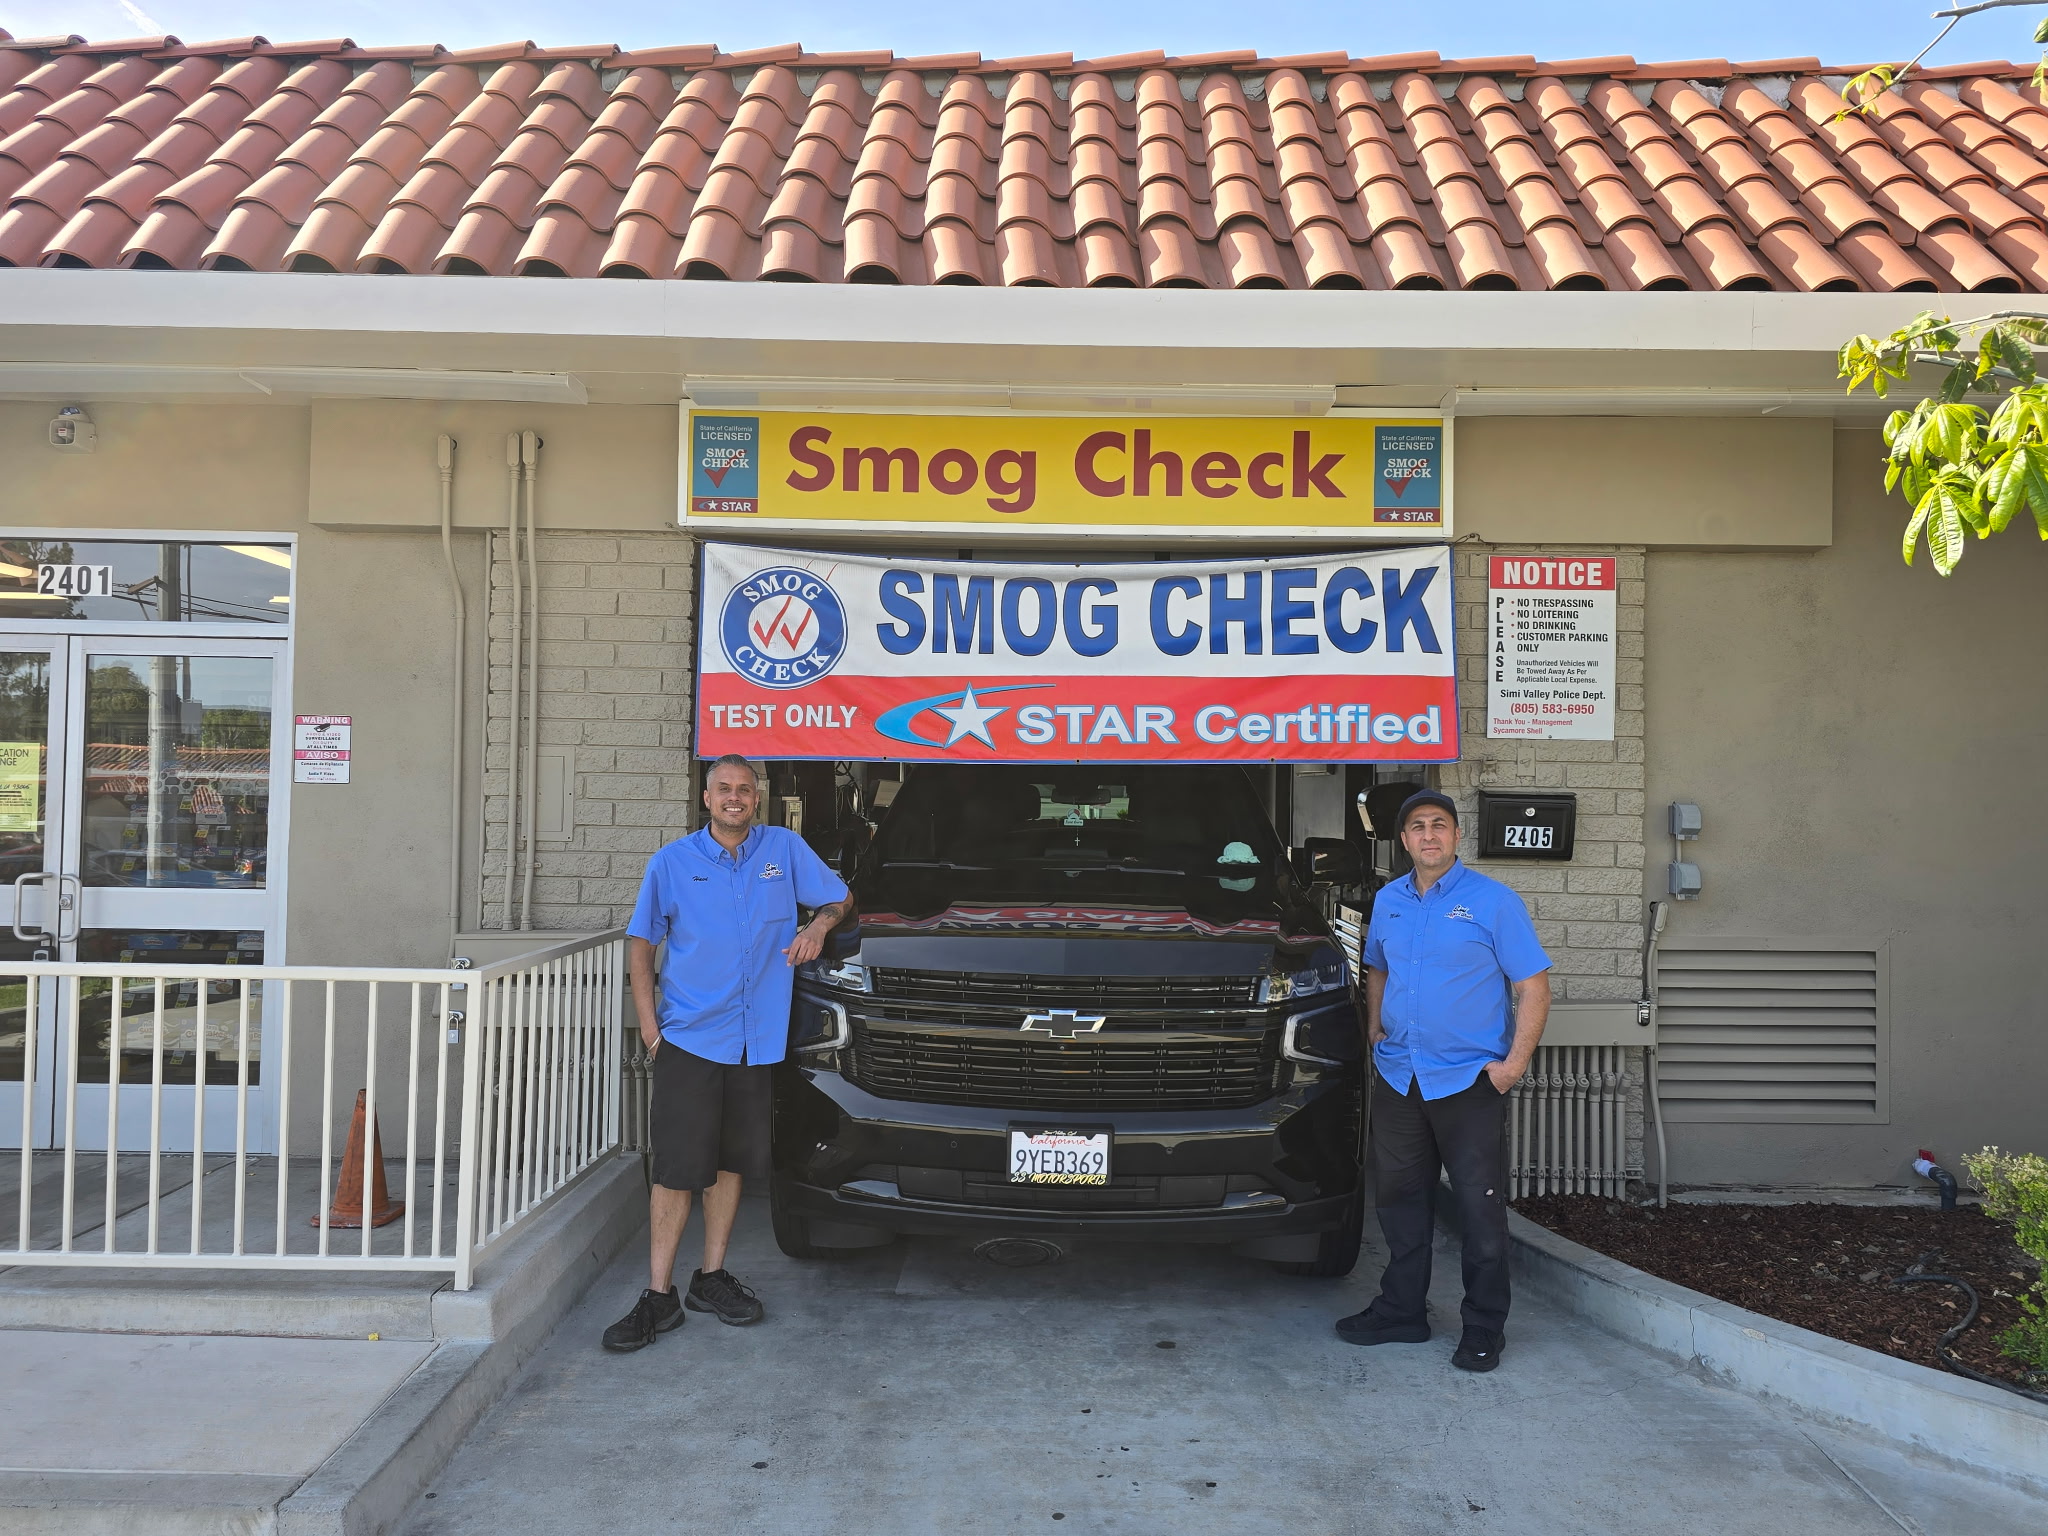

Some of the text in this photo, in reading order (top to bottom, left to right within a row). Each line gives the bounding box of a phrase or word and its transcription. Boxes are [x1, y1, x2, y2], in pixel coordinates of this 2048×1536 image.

[701, 432, 751, 441] LICENSED
[1382, 442, 1434, 451] LICENSED
[706, 448, 746, 458] SMOG
[702, 458, 750, 468] CHECK
[1387, 458, 1428, 468] SMOG
[785, 426, 1347, 514] Smog Check
[1383, 468, 1432, 478] CHECK
[721, 502, 752, 512] STAR
[1403, 511, 1434, 521] STAR
[1503, 561, 1602, 586] NOTICE
[40, 565, 110, 595] 2401
[742, 574, 823, 603] SMOG
[1517, 598, 1594, 608] NO TRESPASSING
[877, 566, 1443, 657] SMOG CHECK
[1517, 610, 1579, 619] NO LOITERING
[1517, 621, 1576, 631] NO DRINKING
[1496, 597, 1505, 682] PLEASE
[1517, 632, 1608, 642] CUSTOMER PARKING
[1517, 643, 1540, 653] ONLY
[735, 645, 831, 681] CHECK
[1516, 676, 1550, 684] Applicable
[1500, 689, 1606, 701] Simi Valley Police Dept.
[1510, 703, 1595, 715] (805) 583-6950
[302, 716, 348, 724] WARNING
[709, 704, 858, 728] TEST ONLY
[1015, 703, 1442, 745] STAR Certified
[1532, 718, 1573, 727] Management
[1493, 727, 1525, 735] Sycamore
[306, 751, 339, 759] AVISO
[1506, 827, 1551, 847] 2405
[1030, 1135, 1092, 1149] California
[1015, 1149, 1104, 1175] 9YEB369
[1010, 1171, 1107, 1186] SS MOTORSPORTS
